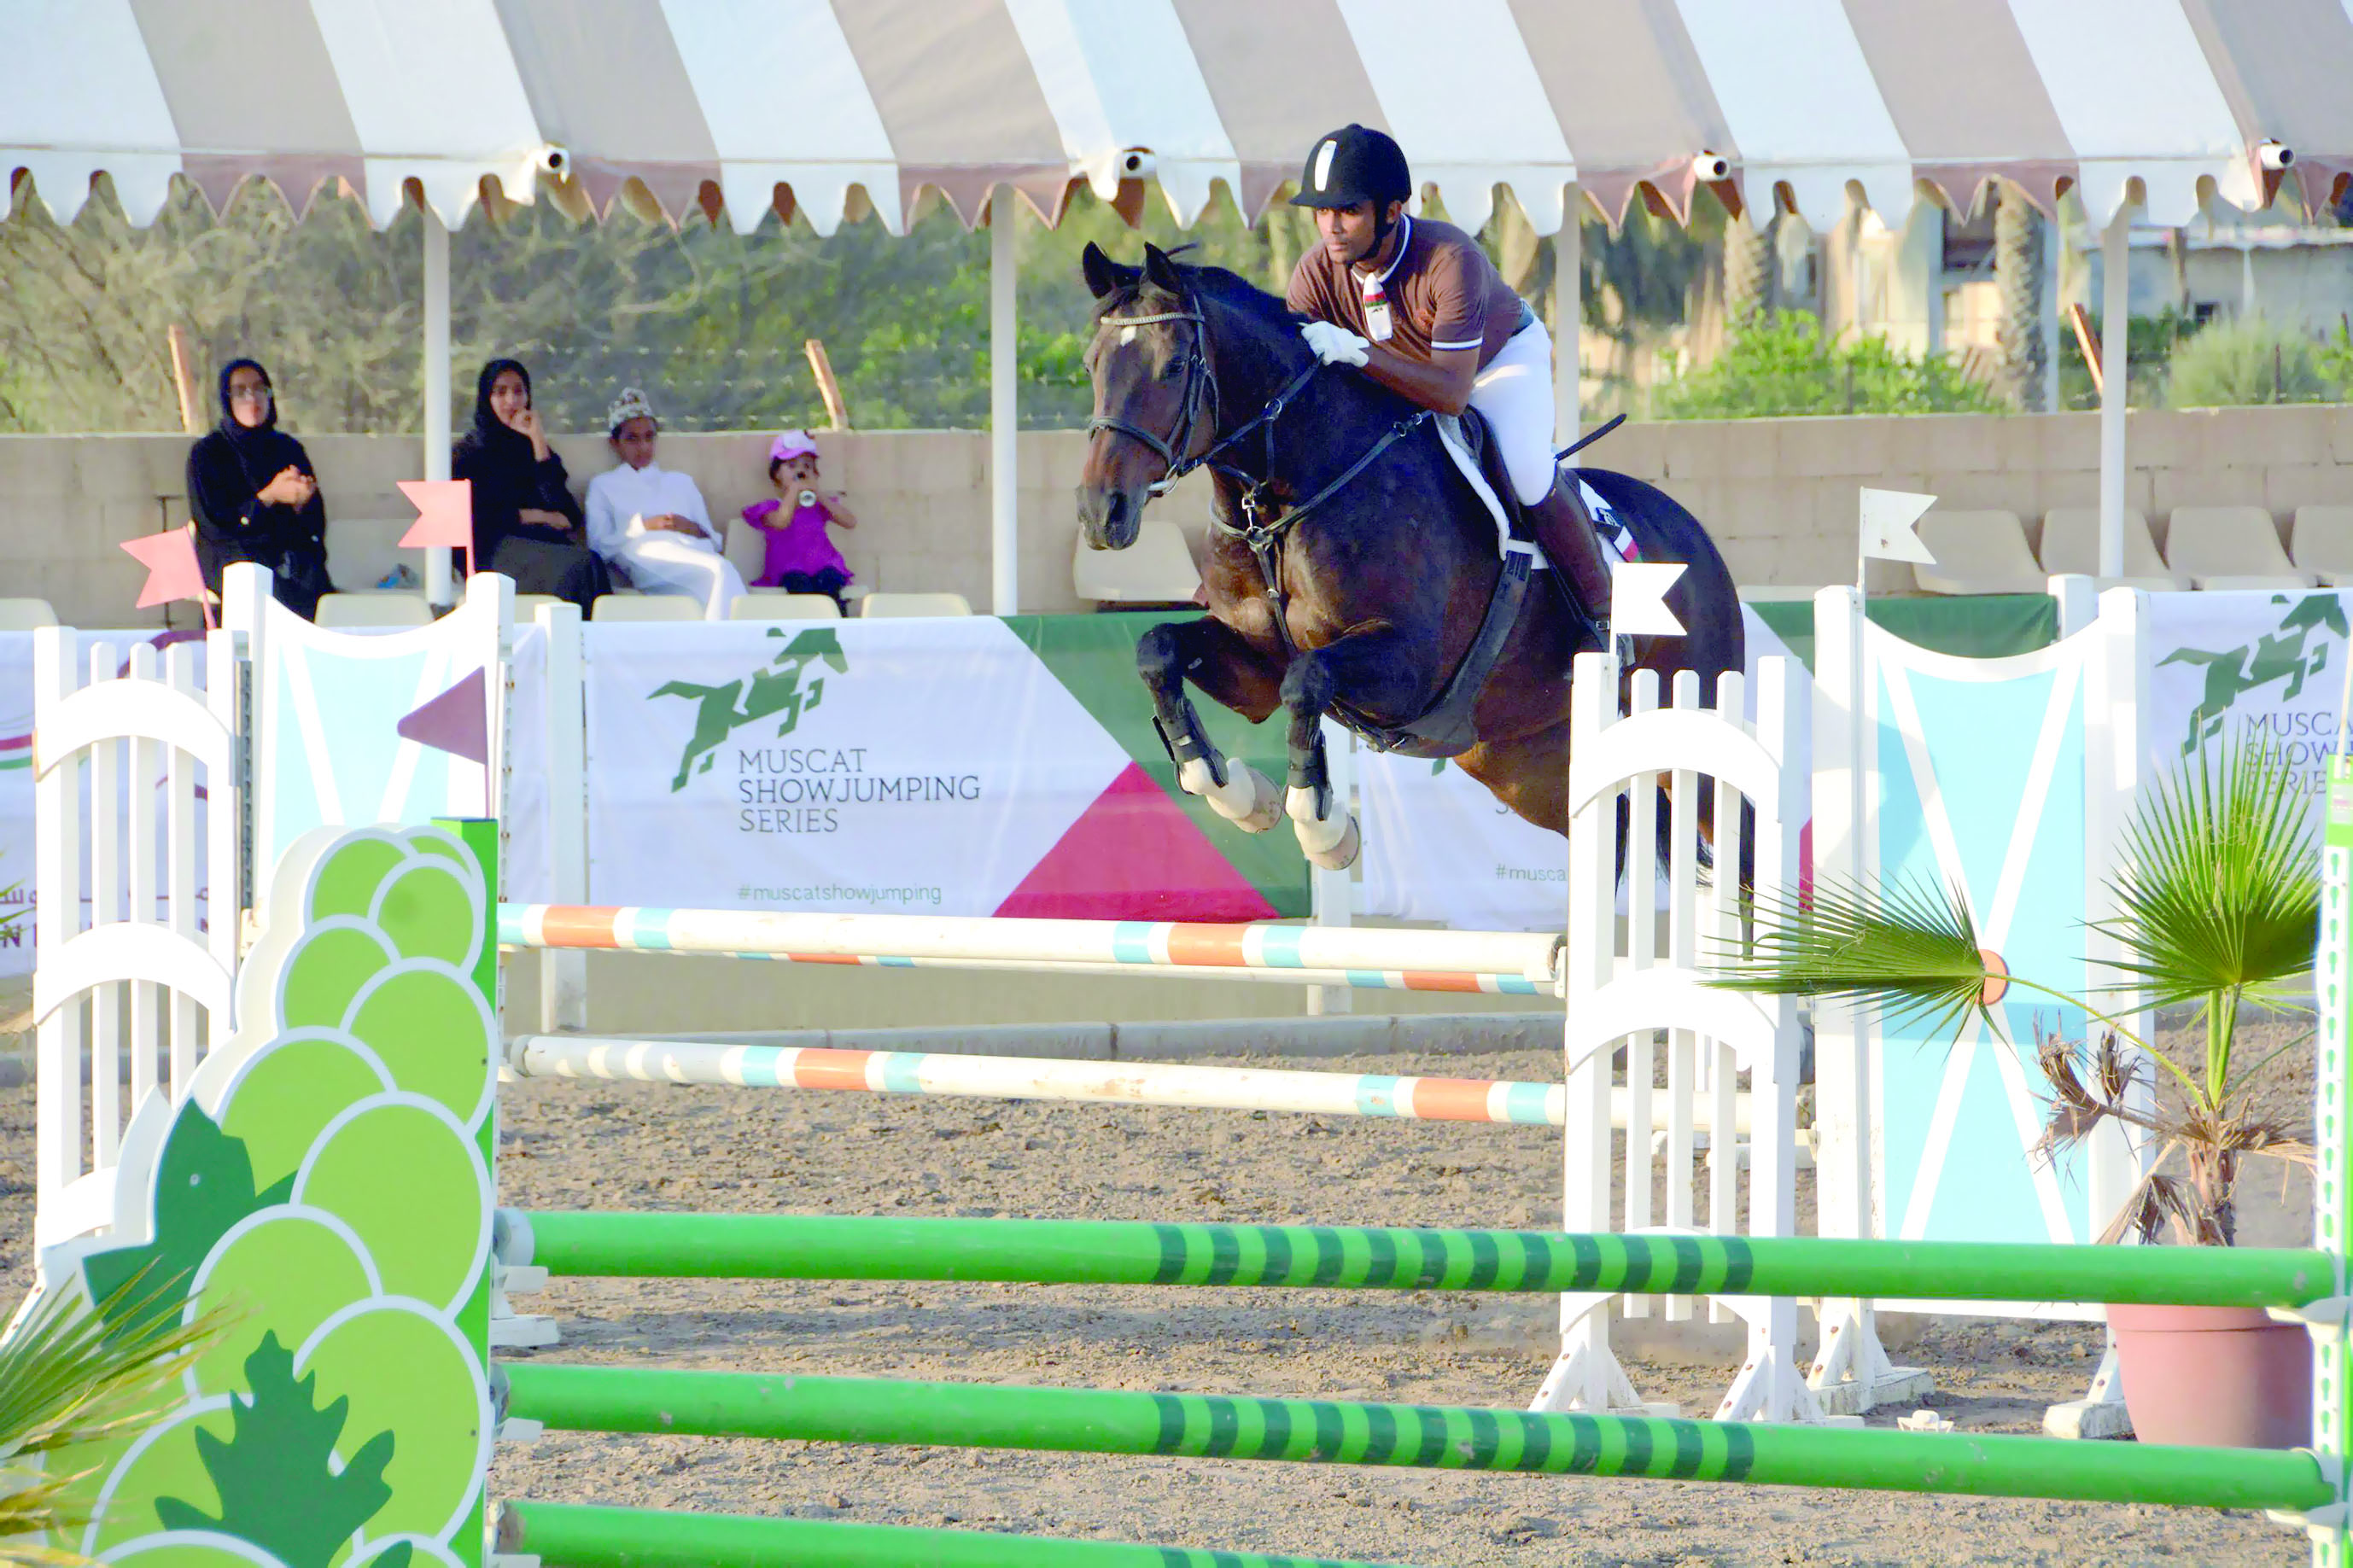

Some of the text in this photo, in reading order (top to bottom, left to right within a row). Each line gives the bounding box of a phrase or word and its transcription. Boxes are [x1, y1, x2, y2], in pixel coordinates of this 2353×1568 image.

[739, 749, 867, 773] MUSCAT
[739, 775, 981, 804] SHOWJUMPING
[739, 808, 838, 833] SERIES
[738, 883, 942, 904] #muscatshowjumping
